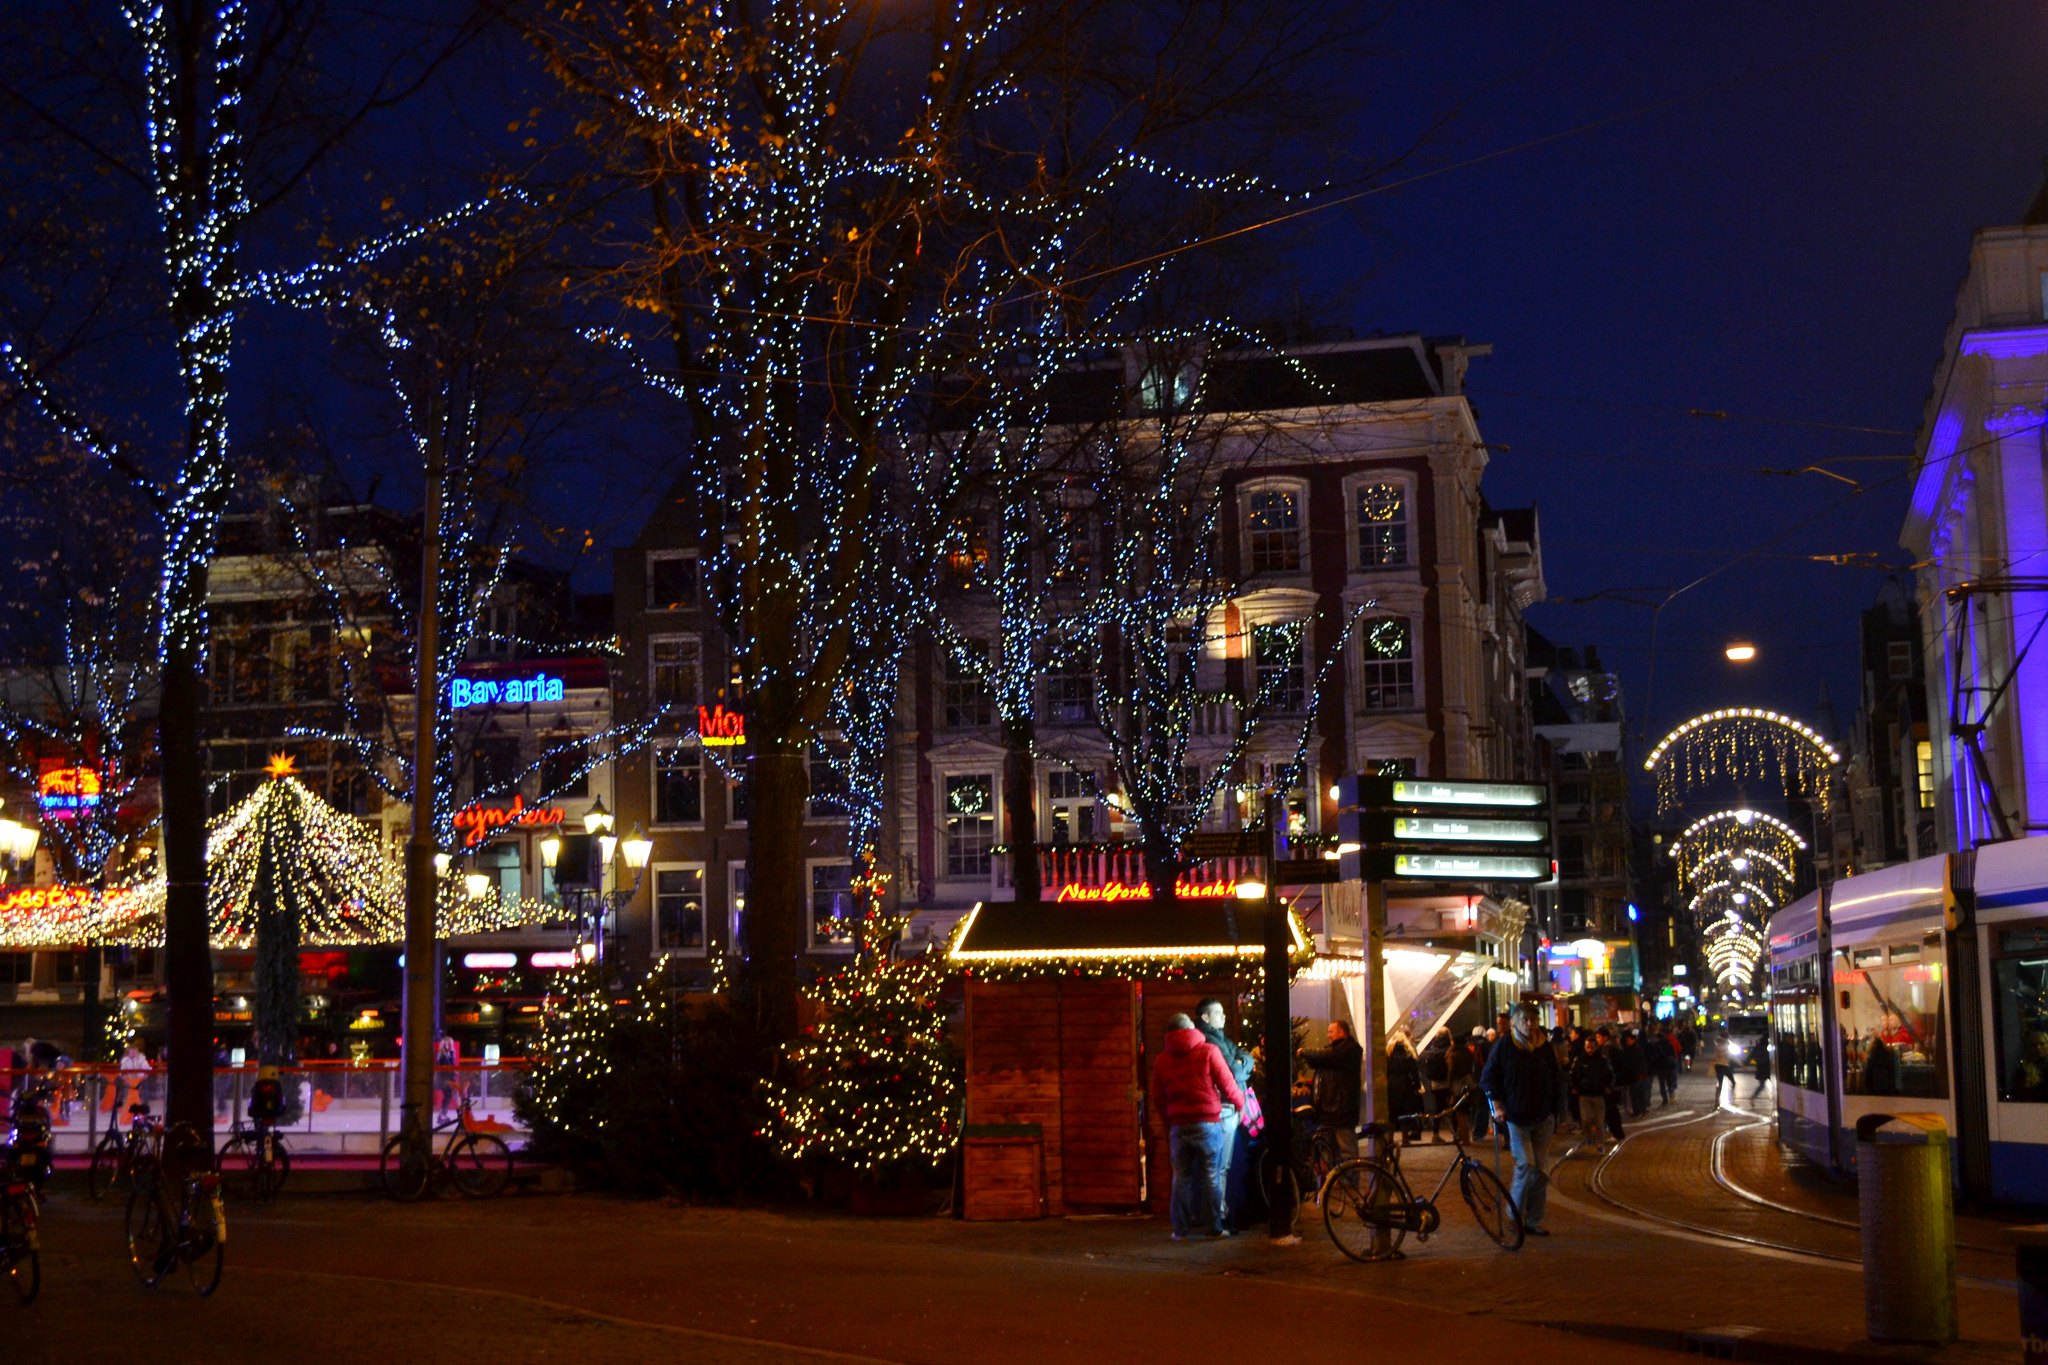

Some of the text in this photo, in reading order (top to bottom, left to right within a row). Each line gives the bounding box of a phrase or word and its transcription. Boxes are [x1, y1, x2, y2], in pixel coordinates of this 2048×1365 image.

[451, 672, 564, 708] Bavaria
[1409, 819, 1419, 834] 2
[1411, 856, 1421, 871] 5
